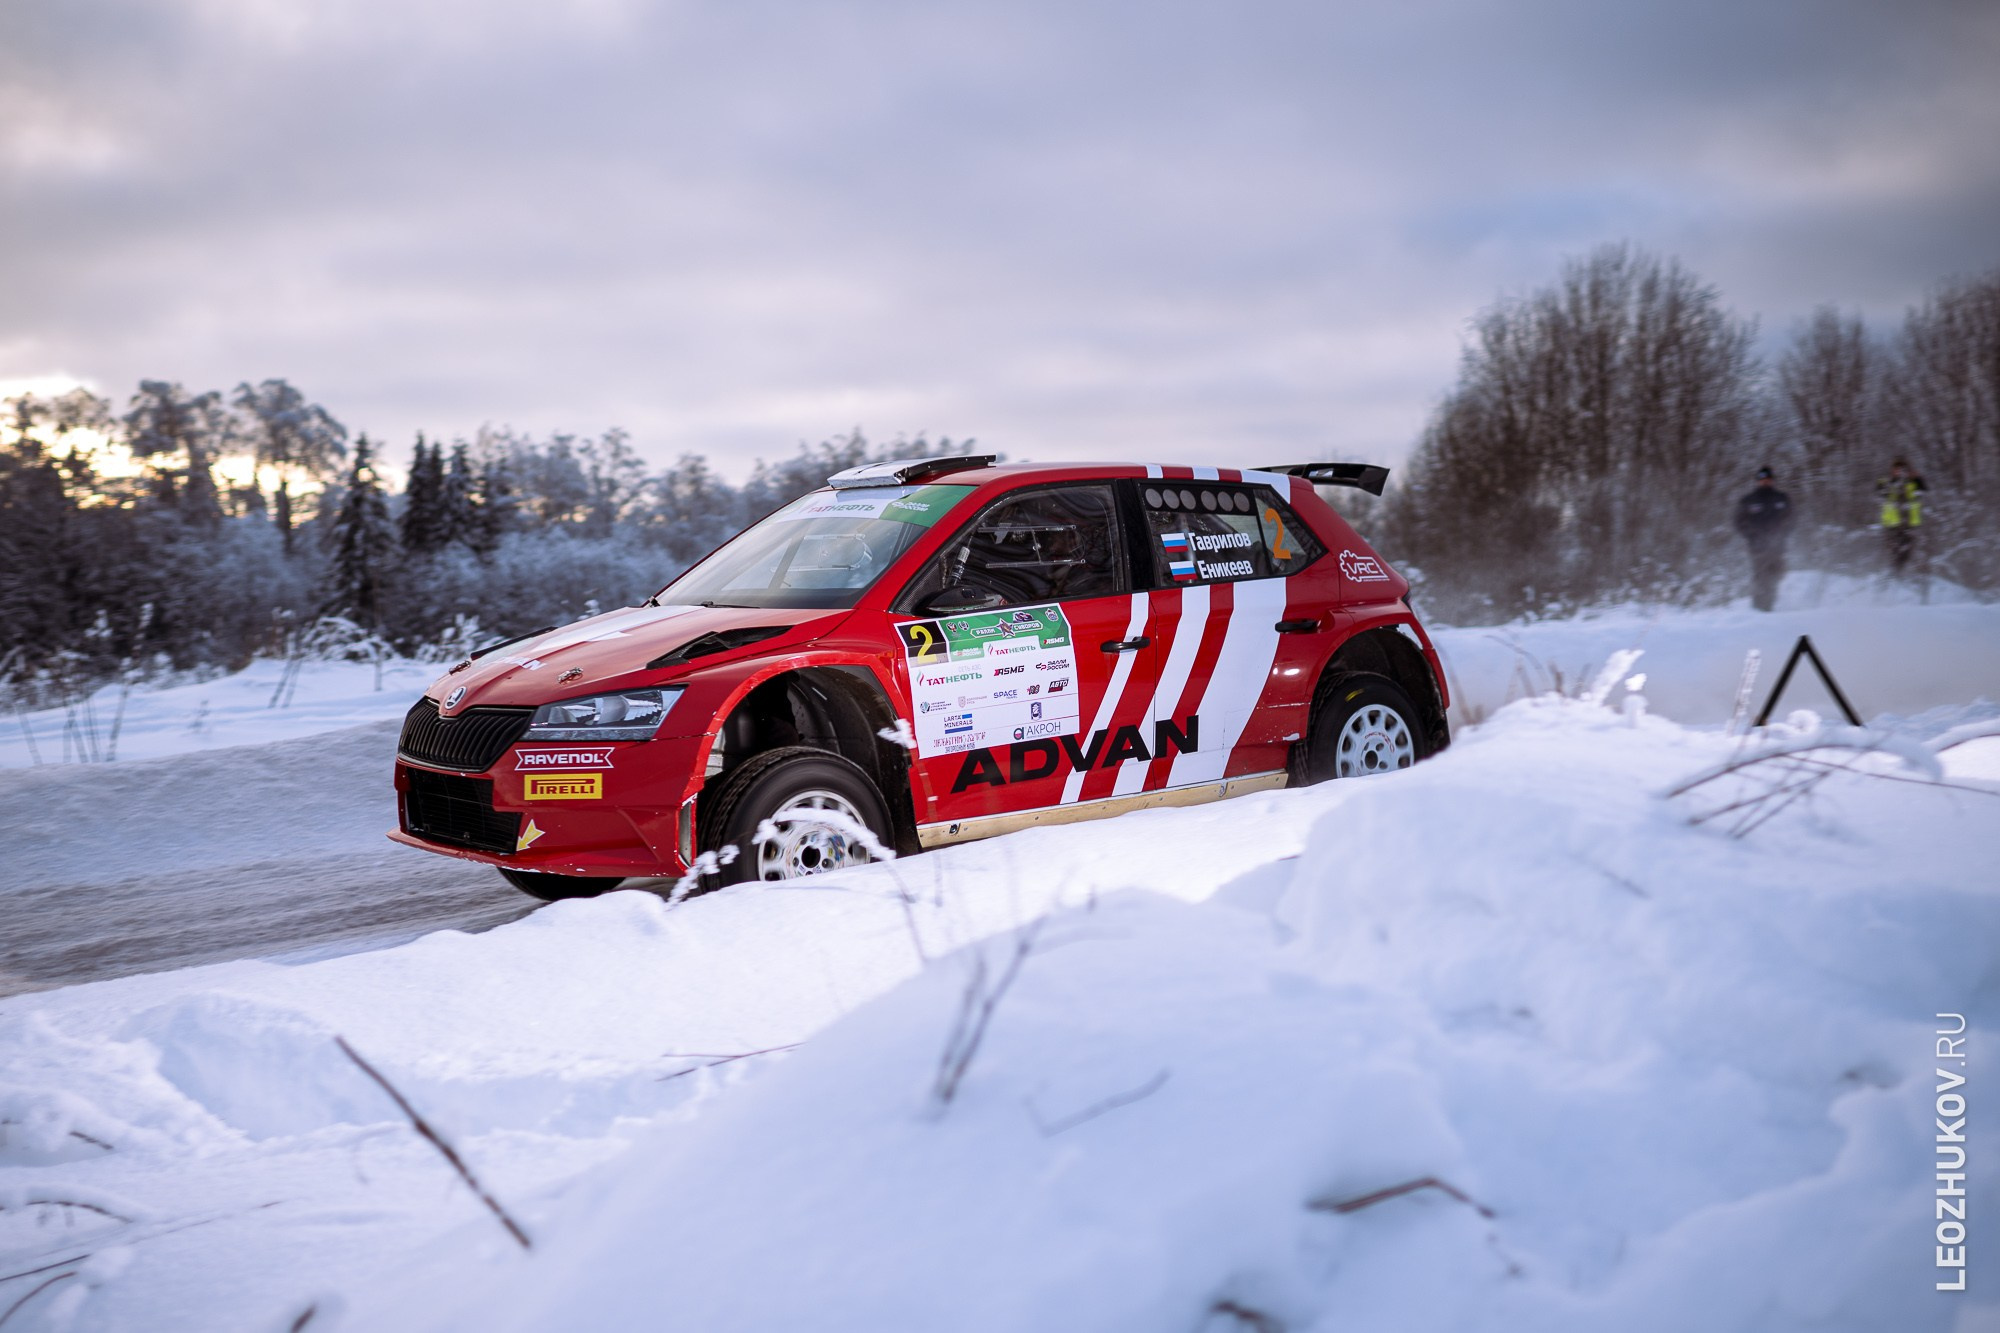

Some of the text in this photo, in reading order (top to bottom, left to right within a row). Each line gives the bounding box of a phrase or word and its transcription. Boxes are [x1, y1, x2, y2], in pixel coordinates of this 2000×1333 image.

[1264, 508, 1292, 560] 2
[1188, 532, 1252, 553] Гаврилов
[1197, 560, 1254, 580] Еникеев
[1346, 562, 1379, 574] VRC
[909, 625, 938, 665] 2
[995, 645, 1036, 656] ТАТНЕФТЬ
[996, 665, 1025, 676] ASMG
[926, 672, 983, 686] ТАТНЕФТЬ
[993, 689, 1018, 699] SPACE
[944, 719, 973, 728] MINERALS
[1026, 721, 1061, 736] АКРОН
[524, 753, 604, 765] RAVENOL
[950, 714, 1200, 794] ADVAN
[530, 778, 596, 794] PIRELLI
